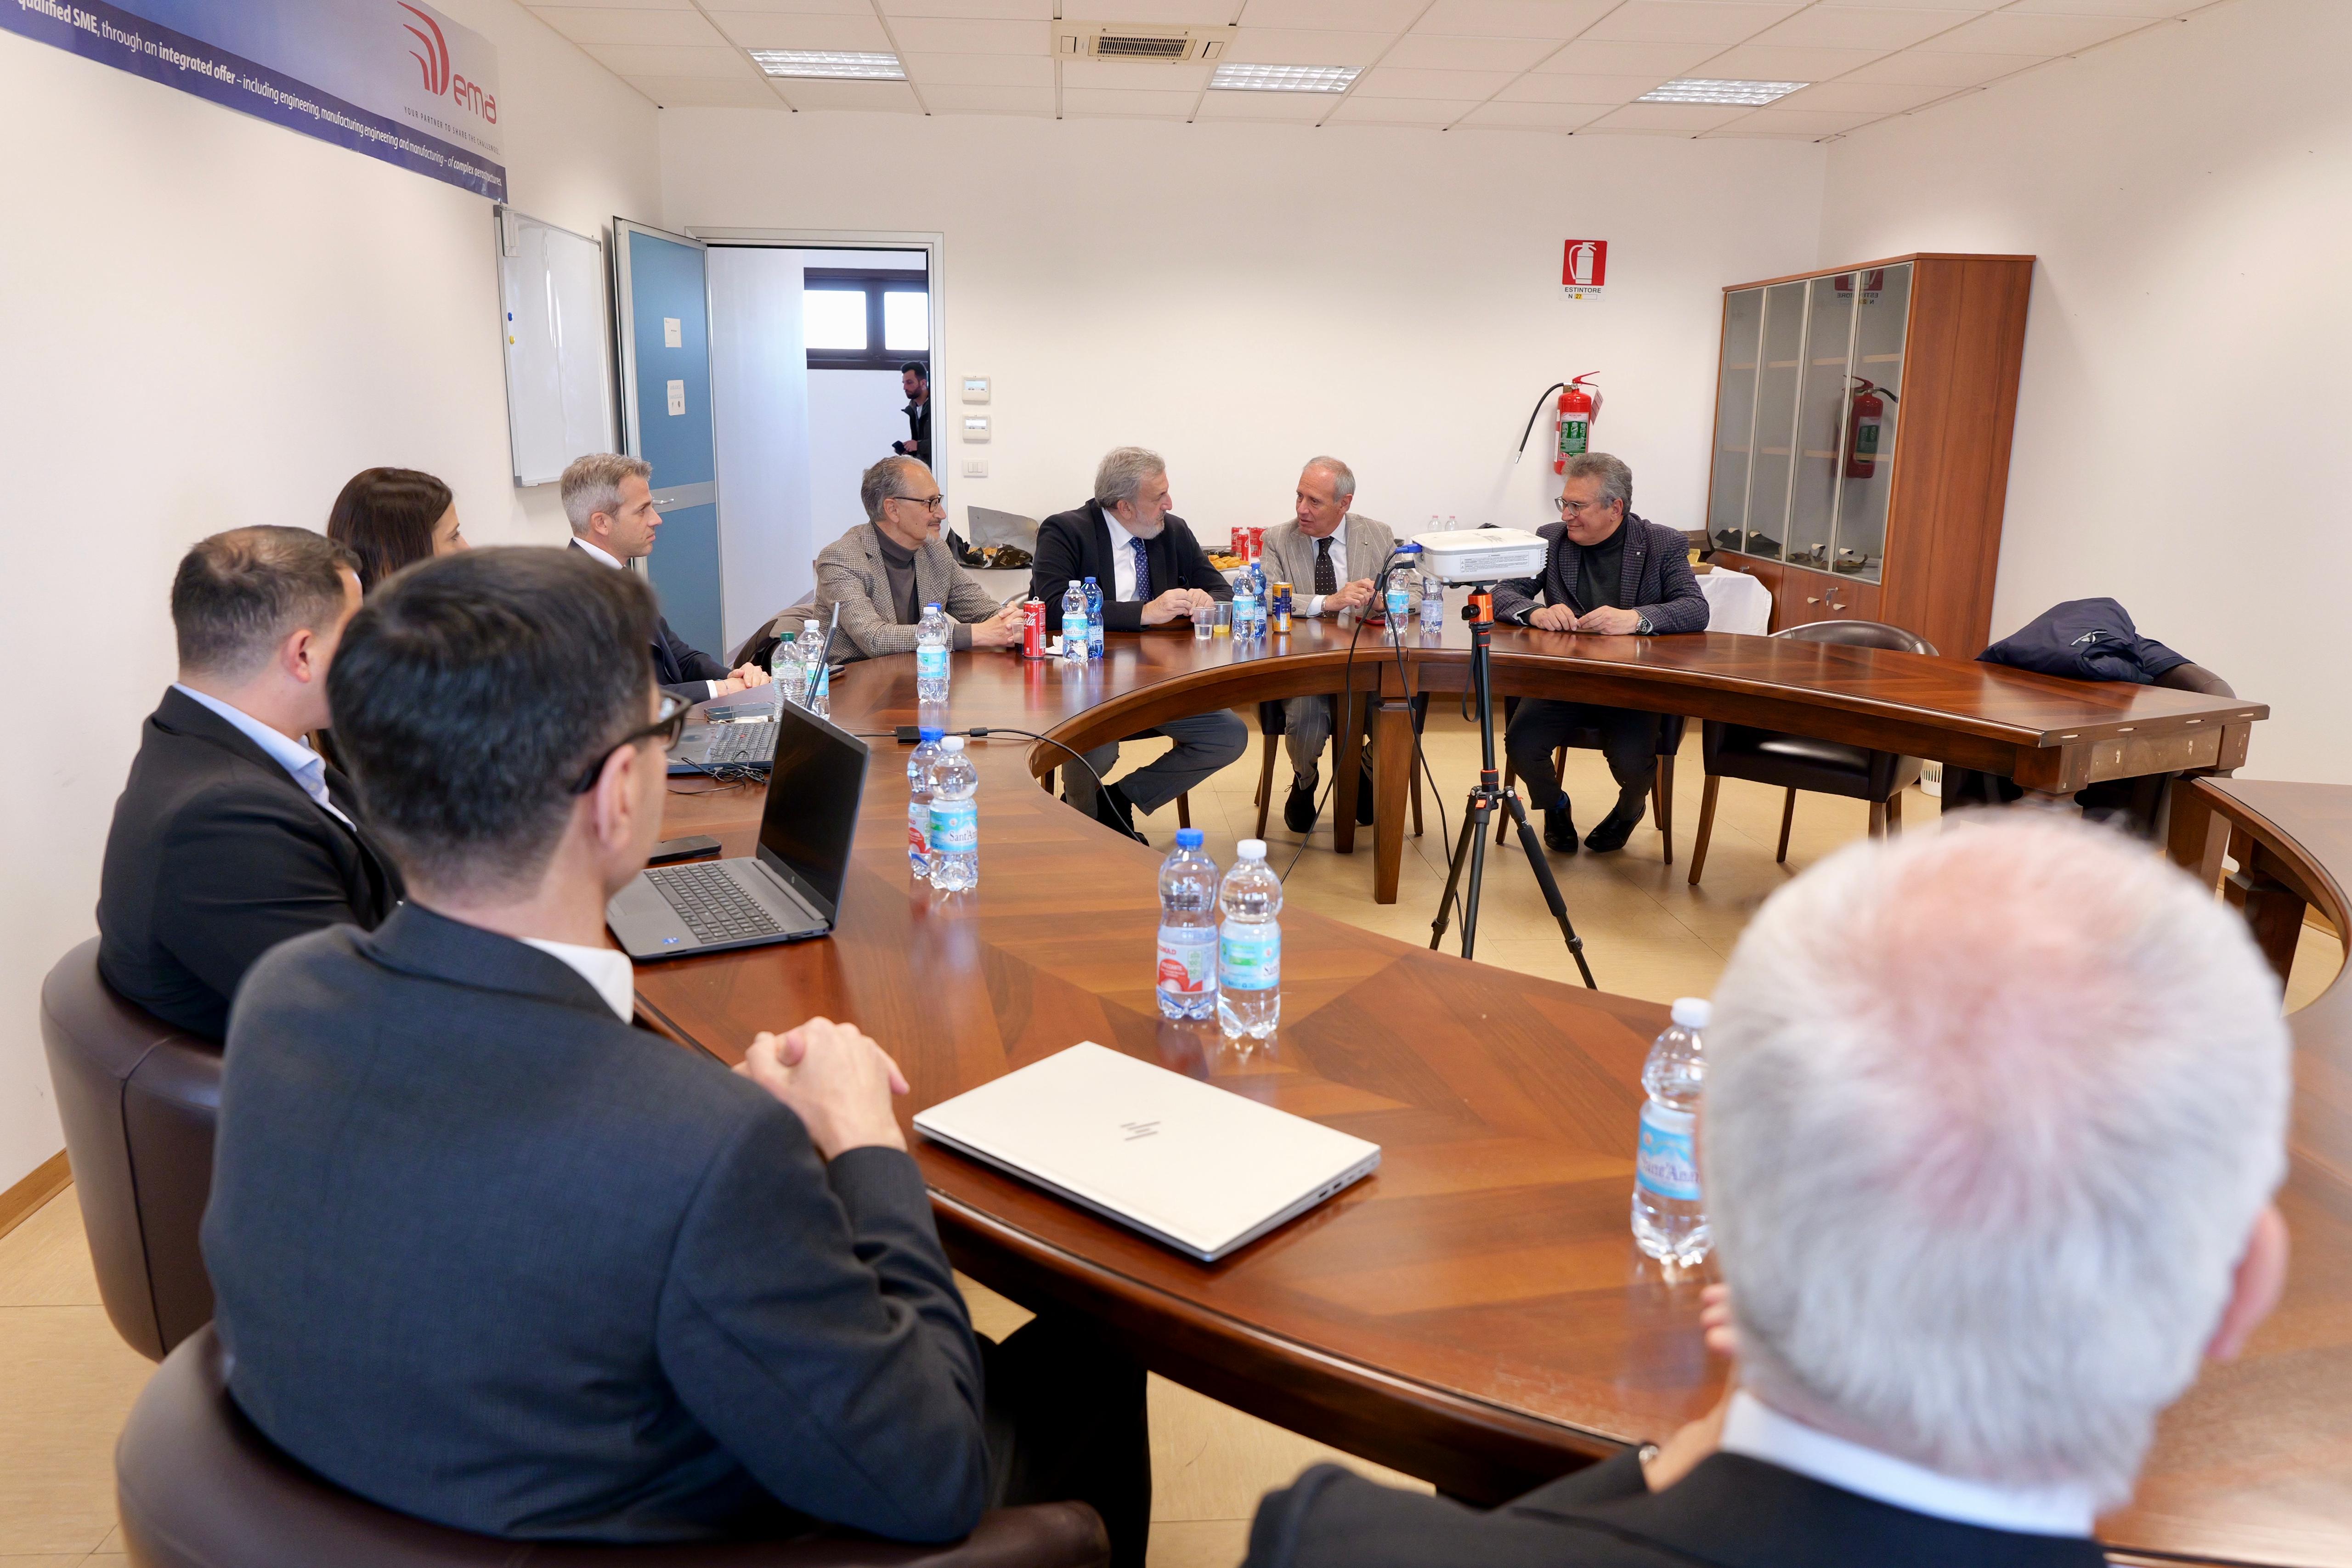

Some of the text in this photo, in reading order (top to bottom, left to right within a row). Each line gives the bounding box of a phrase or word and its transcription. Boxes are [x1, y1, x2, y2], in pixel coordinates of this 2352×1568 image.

[19, 0, 71, 23] qualified
[74, 8, 100, 37] SME,
[102, 20, 142, 52] through
[144, 41, 157, 56] an
[159, 41, 212, 76] integrated
[214, 64, 235, 84] offer
[243, 74, 278, 104] including
[280, 93, 320, 119] engineering,
[321, 108, 363, 137] manufacturing
[364, 126, 398, 149] engineering
[399, 138, 409, 150] and
[409, 144, 444, 166] manufacturing
[447, 156, 454, 166] of
[453, 162, 474, 175] complex
[404, 106, 418, 119] YOUR
[421, 113, 443, 128] PARTNER
[445, 123, 451, 132] TO
[453, 127, 467, 139] SHARE
